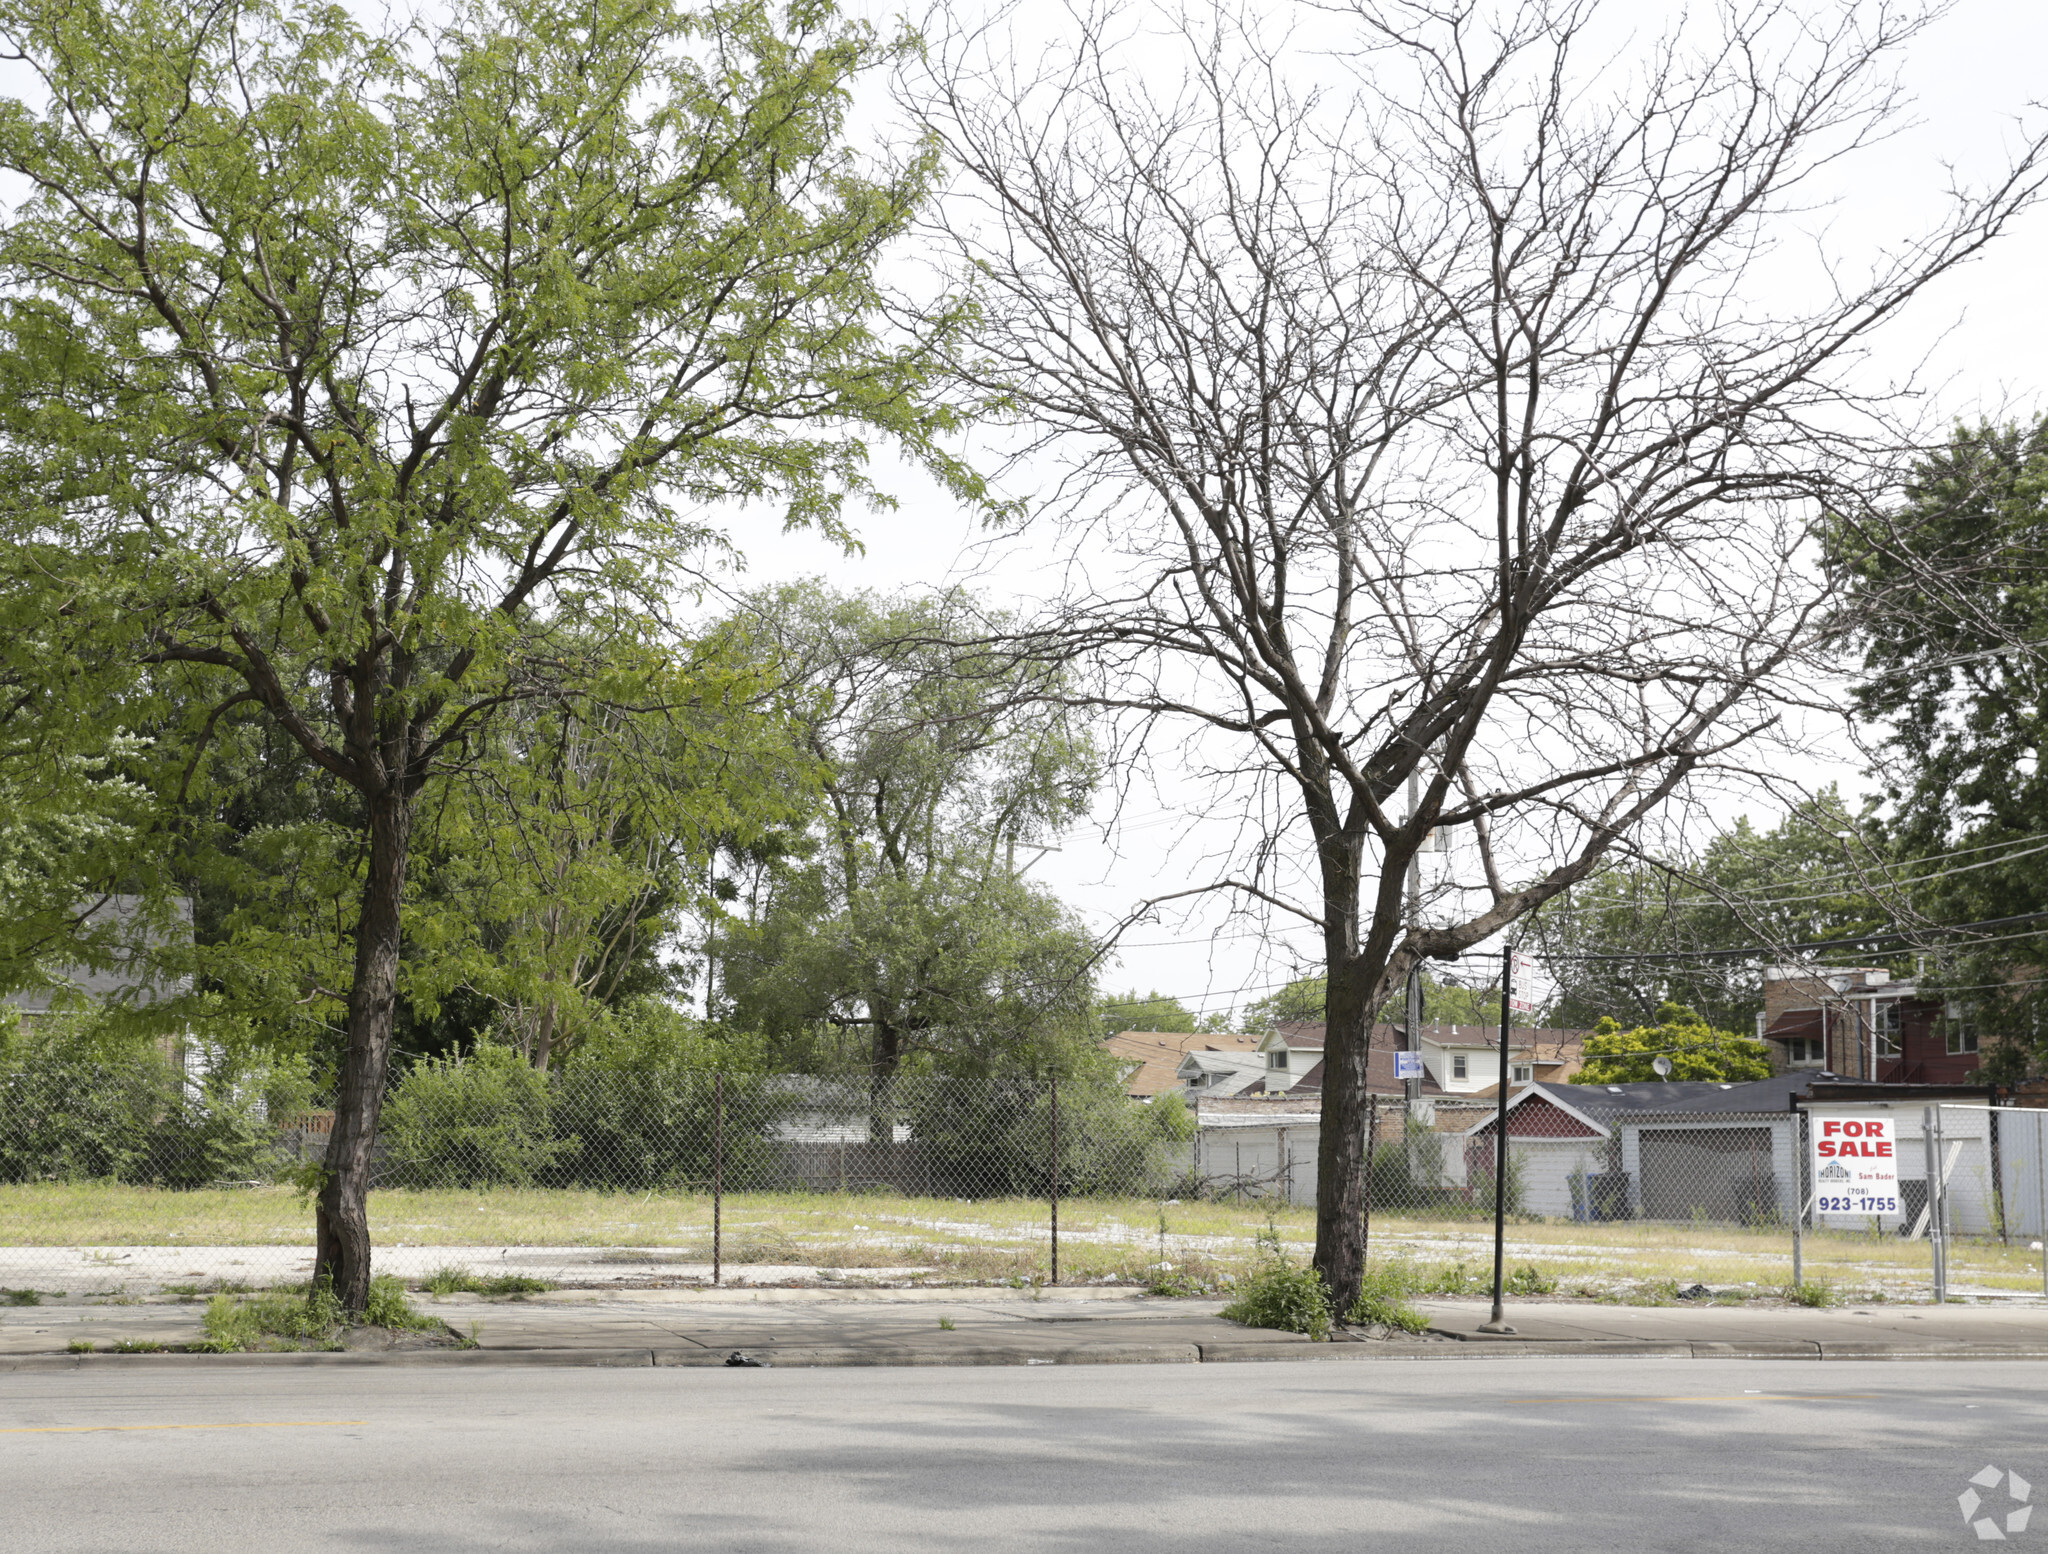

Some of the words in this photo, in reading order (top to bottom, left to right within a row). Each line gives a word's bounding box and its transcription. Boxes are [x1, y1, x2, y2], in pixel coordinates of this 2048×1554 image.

[1823, 1121, 1884, 1137] FOR
[1817, 1141, 1893, 1157] SALE
[1820, 1165, 1849, 1178] HORIZON
[1858, 1172, 1873, 1180] Sam
[1875, 1172, 1895, 1180] Bader
[1847, 1188, 1869, 1196] (708)
[1819, 1197, 1896, 1211] 923-1755
